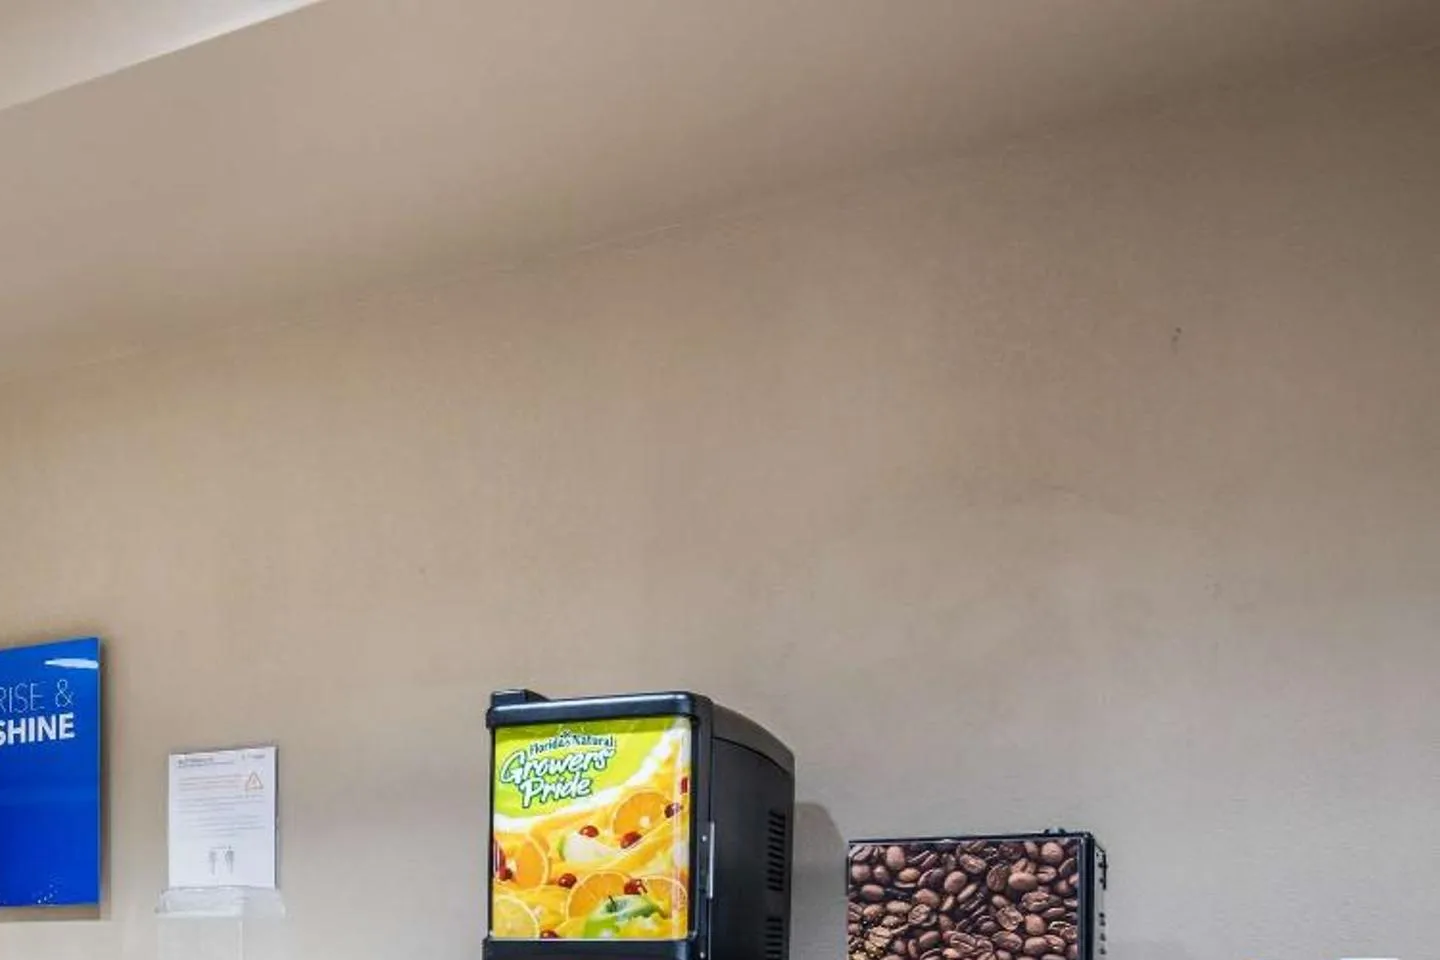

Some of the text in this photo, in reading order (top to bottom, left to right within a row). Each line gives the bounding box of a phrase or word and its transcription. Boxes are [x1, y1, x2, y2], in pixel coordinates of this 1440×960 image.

[55, 679, 74, 708] &
[572, 734, 613, 748] Natural
[520, 771, 592, 808] Pride
